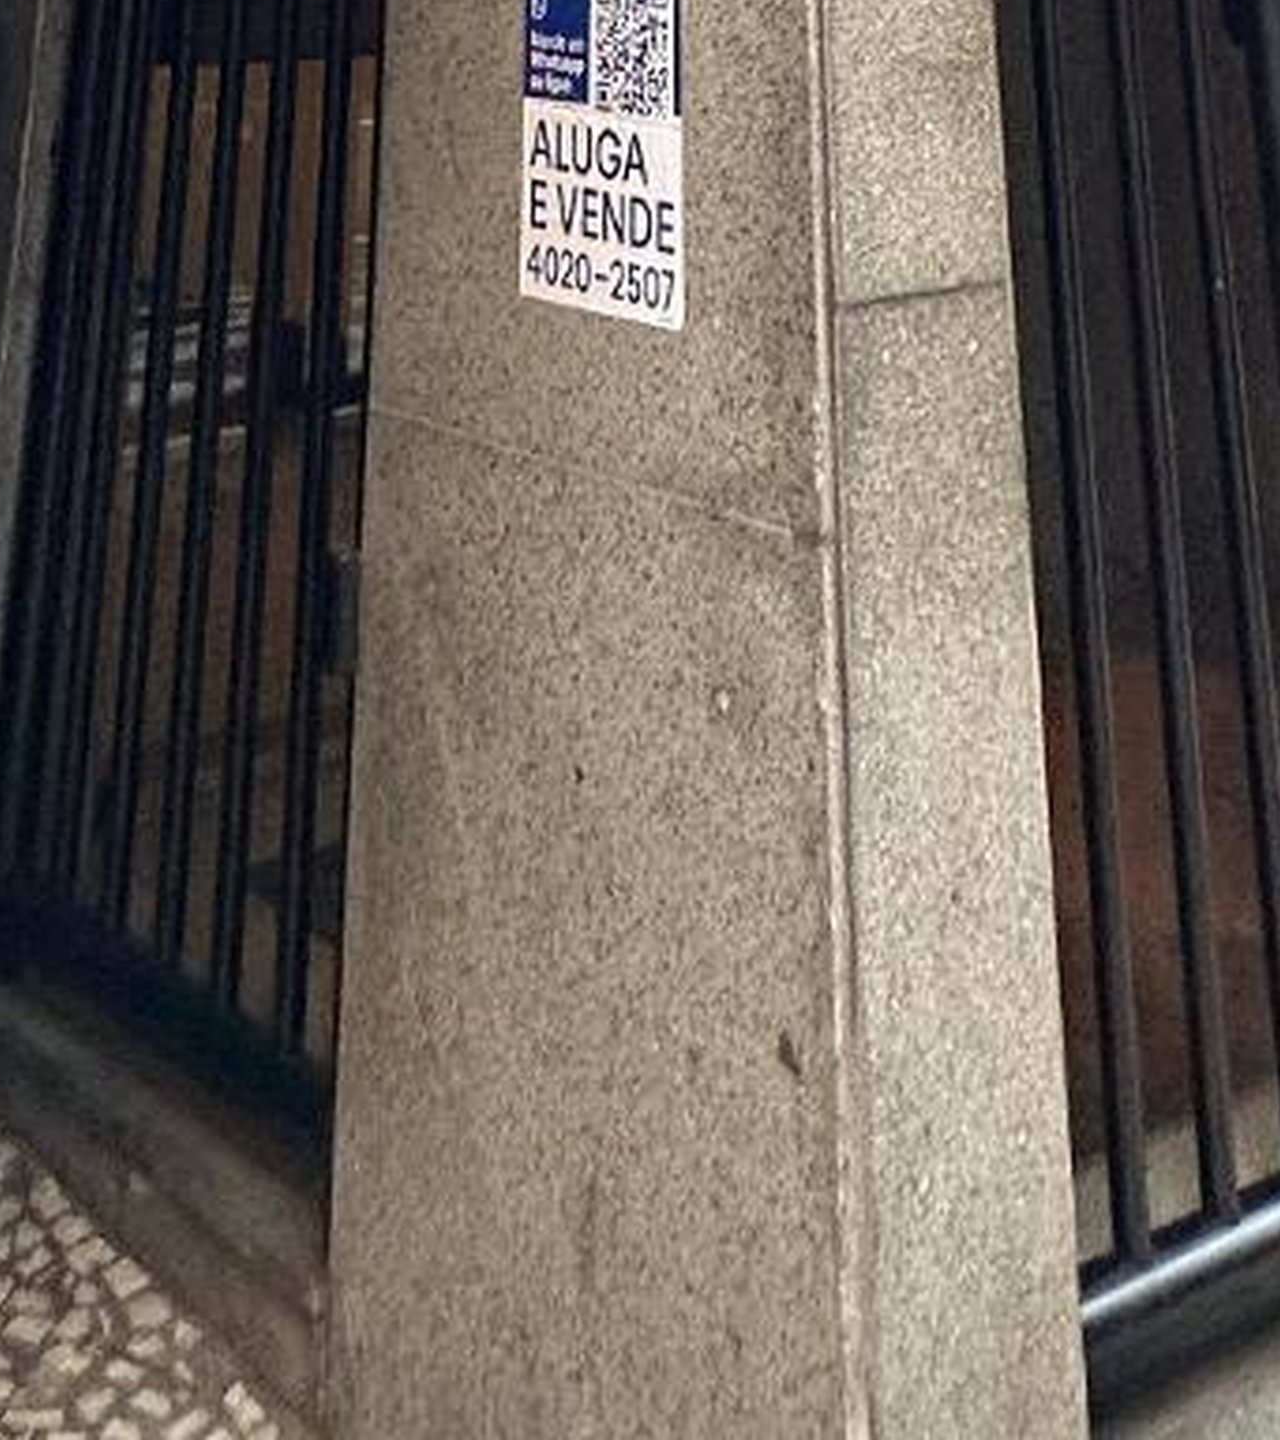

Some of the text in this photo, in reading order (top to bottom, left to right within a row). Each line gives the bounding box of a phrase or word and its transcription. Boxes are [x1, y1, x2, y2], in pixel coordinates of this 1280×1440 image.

[528, 119, 650, 186] ALUGA
[530, 179, 677, 256] E VENDE
[526, 243, 677, 313] 4020-2507
